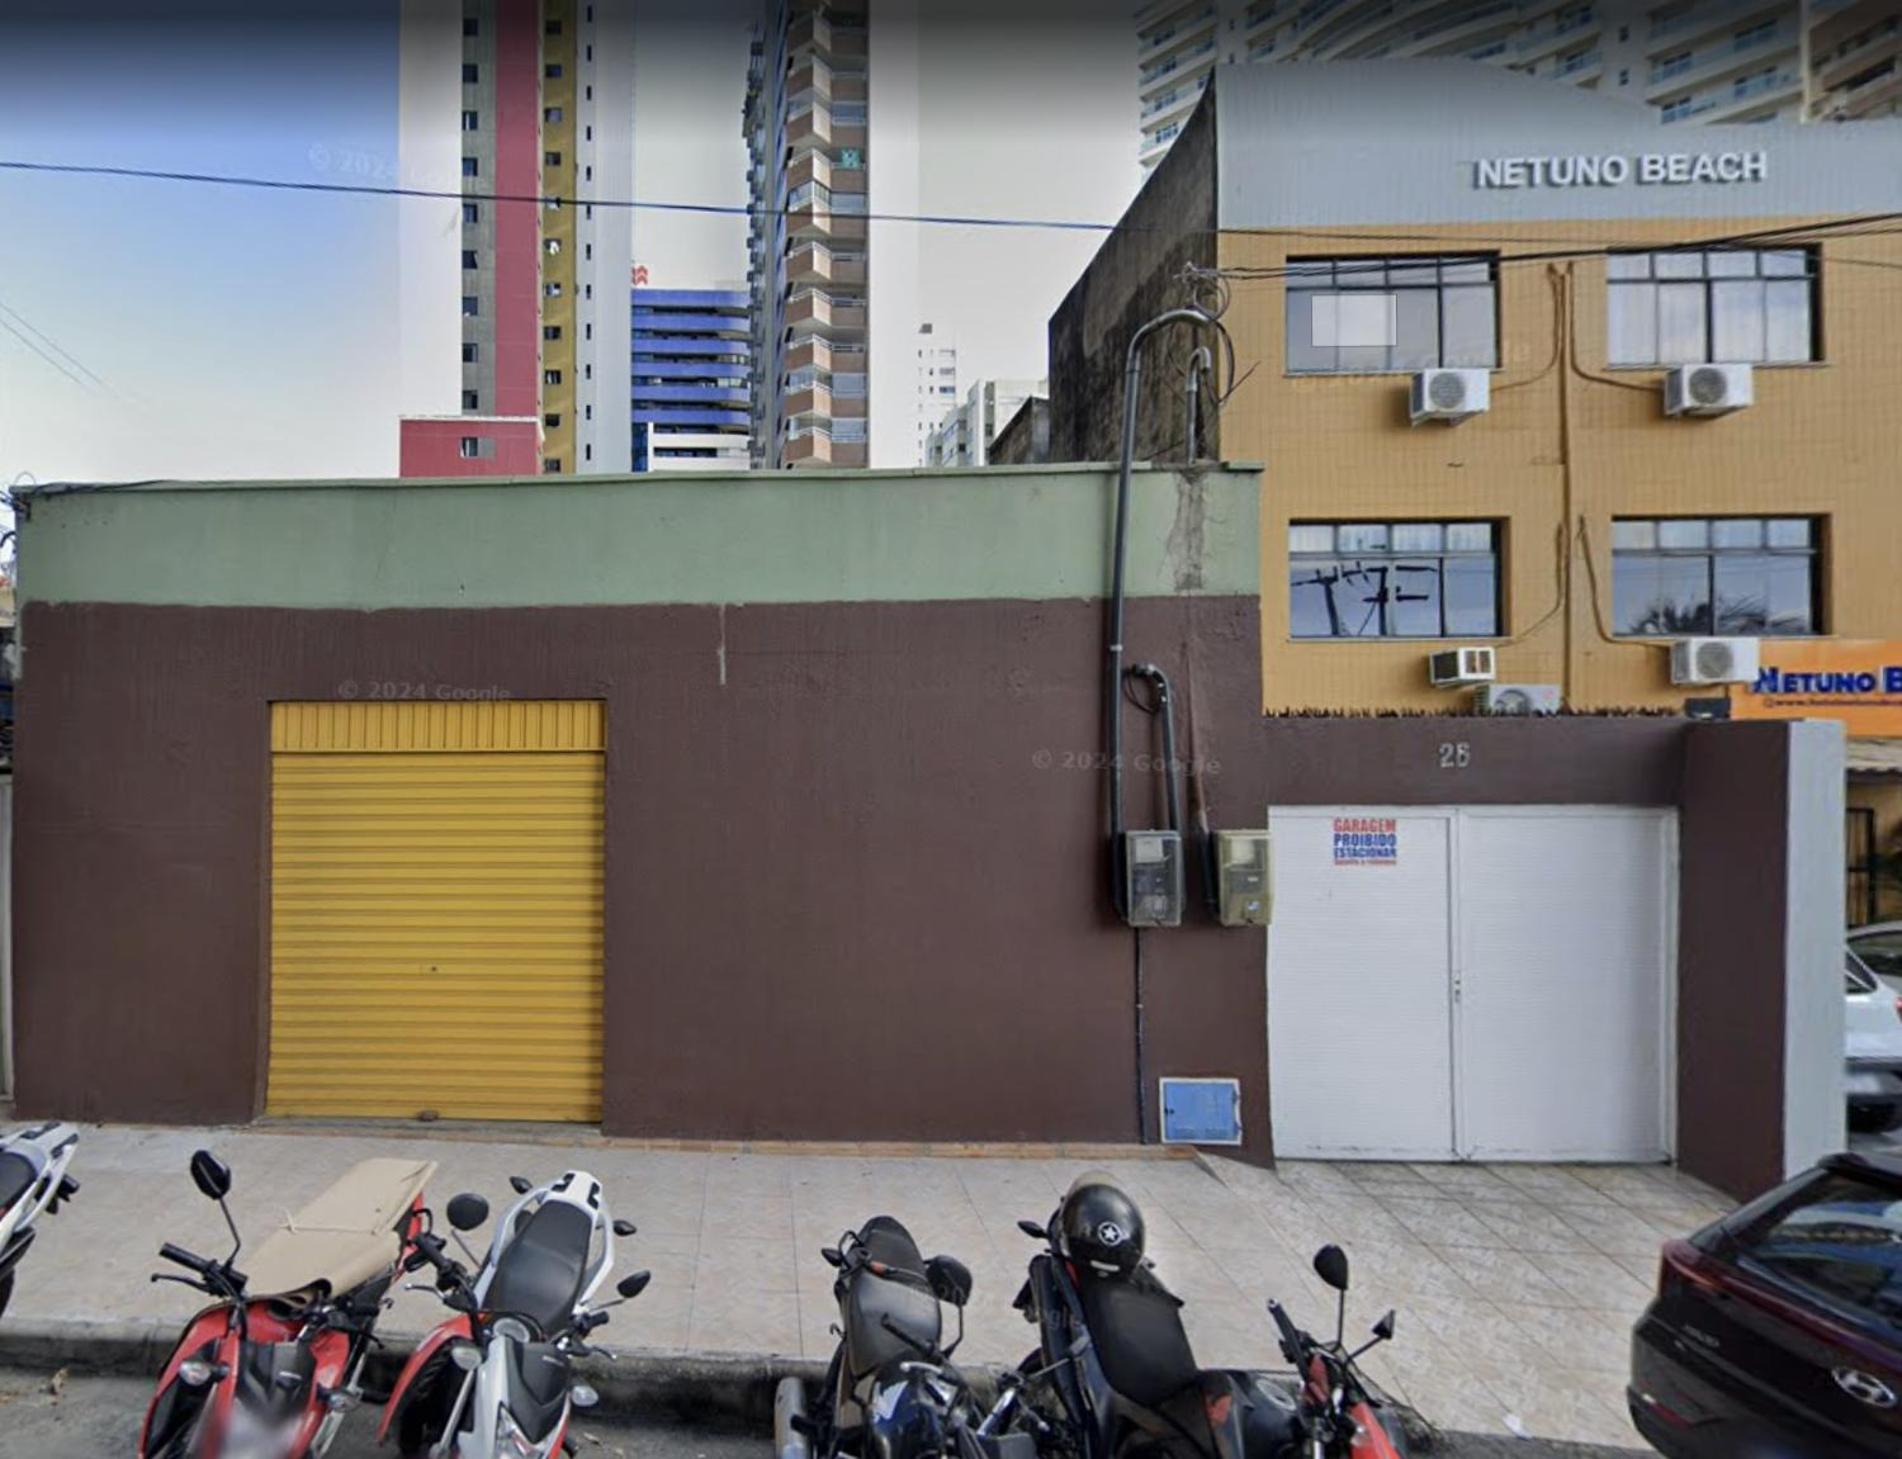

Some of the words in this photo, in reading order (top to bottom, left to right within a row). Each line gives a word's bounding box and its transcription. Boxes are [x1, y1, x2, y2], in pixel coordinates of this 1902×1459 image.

[1474, 156, 1629, 189] NETUNO
[1636, 151, 1768, 185] BEACH
[1754, 667, 1876, 692] NETUNO
[1440, 743, 1470, 768] 26
[1334, 818, 1396, 832] GARAGEM
[1334, 833, 1396, 847] PROIBIDO
